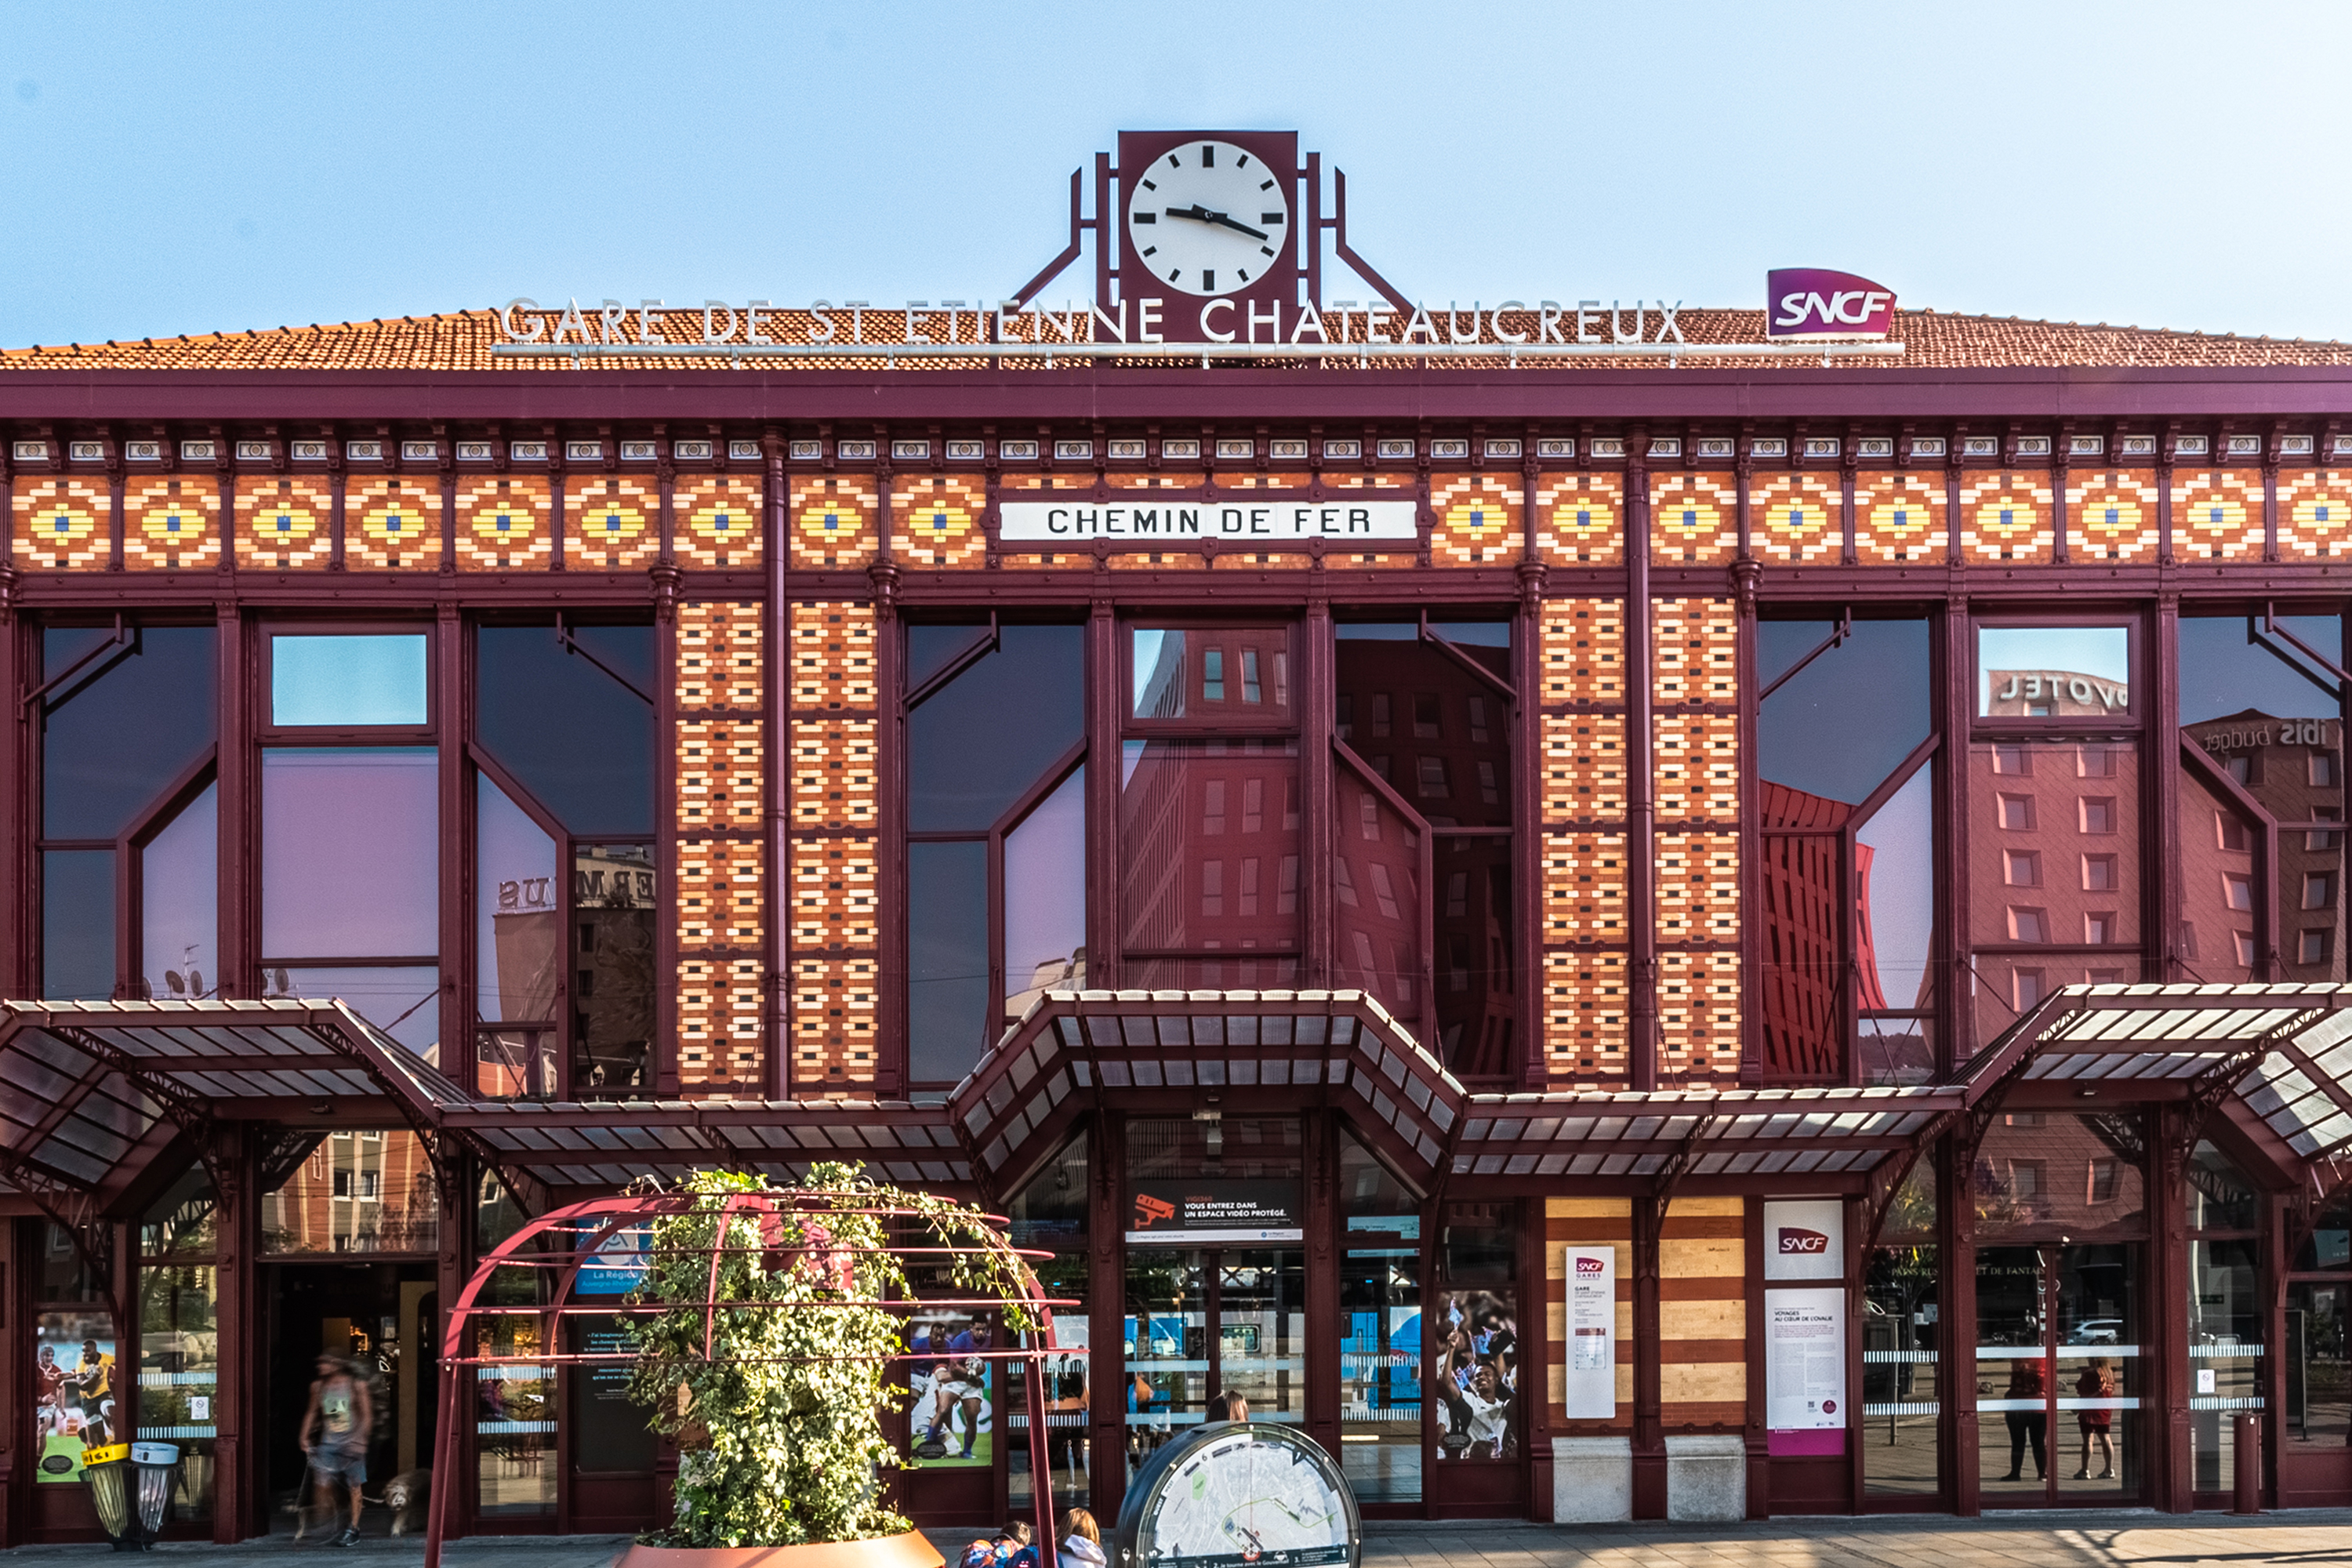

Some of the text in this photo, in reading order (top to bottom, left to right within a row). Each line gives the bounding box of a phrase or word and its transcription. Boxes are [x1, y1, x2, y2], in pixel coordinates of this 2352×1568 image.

[1774, 291, 1894, 328] SNCF
[501, 297, 1686, 344] GARE DE ST ETIENNE CHATEAUCREUX
[1047, 509, 1370, 534] CHEMIN DE FER
[1251, 1208, 1287, 1217] PROTÉGÉ.
[1780, 1236, 1825, 1251] SNCF
[1577, 1262, 1602, 1271] SNCF
[1976, 1267, 1987, 1276] ET
[1990, 1267, 2003, 1276] DE
[2006, 1267, 2045, 1276] FANTAIS
[1201, 1453, 1208, 1461] 6
